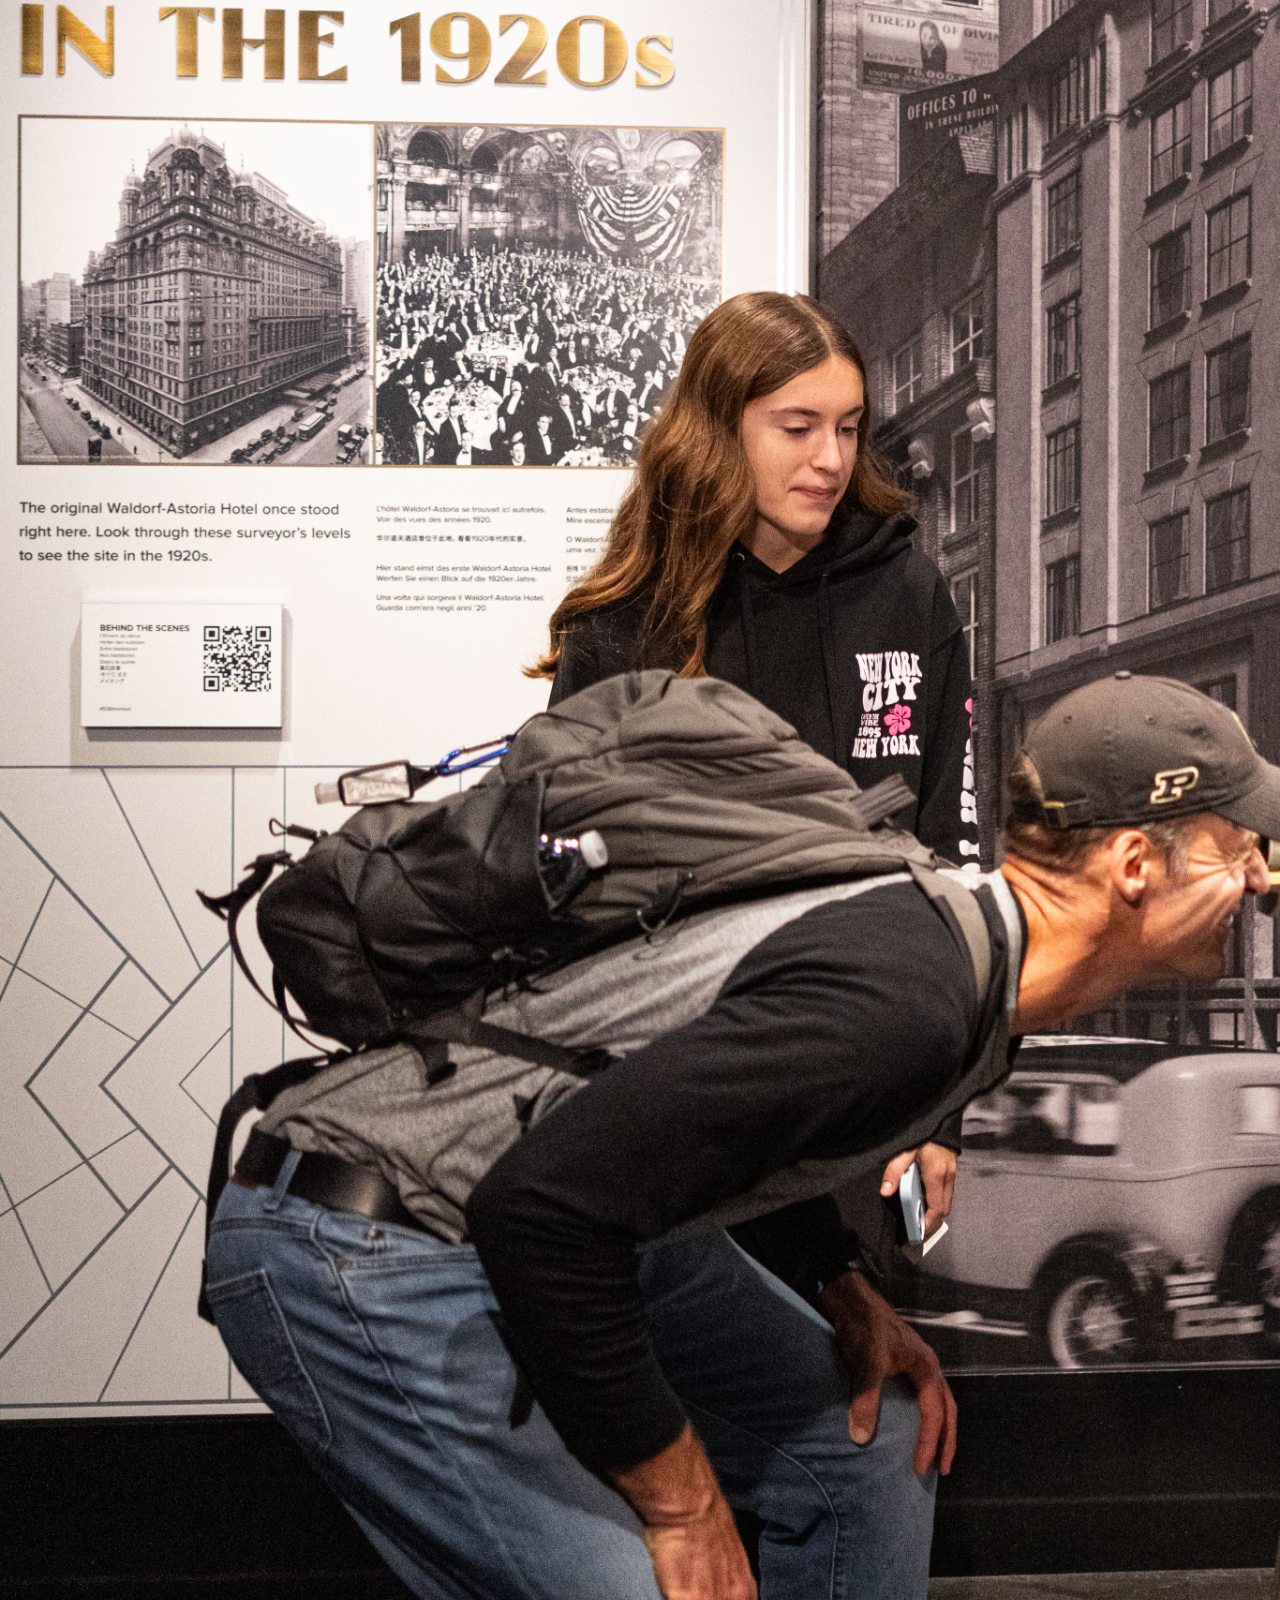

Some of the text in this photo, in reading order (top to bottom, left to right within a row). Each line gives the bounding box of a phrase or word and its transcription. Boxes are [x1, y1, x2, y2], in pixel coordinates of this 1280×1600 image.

[868, 14, 916, 28] TIRED
[942, 25, 959, 35] OF
[21, 4, 675, 87] IN THE 1920s
[907, 88, 977, 120] OFFICES TO
[19, 501, 339, 517] The original Waldorf-Astoria Hotel once stood
[18, 525, 351, 541] right here. Look through these surveyor’s levels
[18, 550, 212, 561] to see the site in the 1920s.
[436, 605, 454, 613] negli
[855, 651, 922, 683] NEW YORK
[862, 677, 921, 712] CITY
[857, 727, 882, 738] 1895
[852, 735, 921, 758] NEW YORK
[1150, 766, 1198, 804] P
